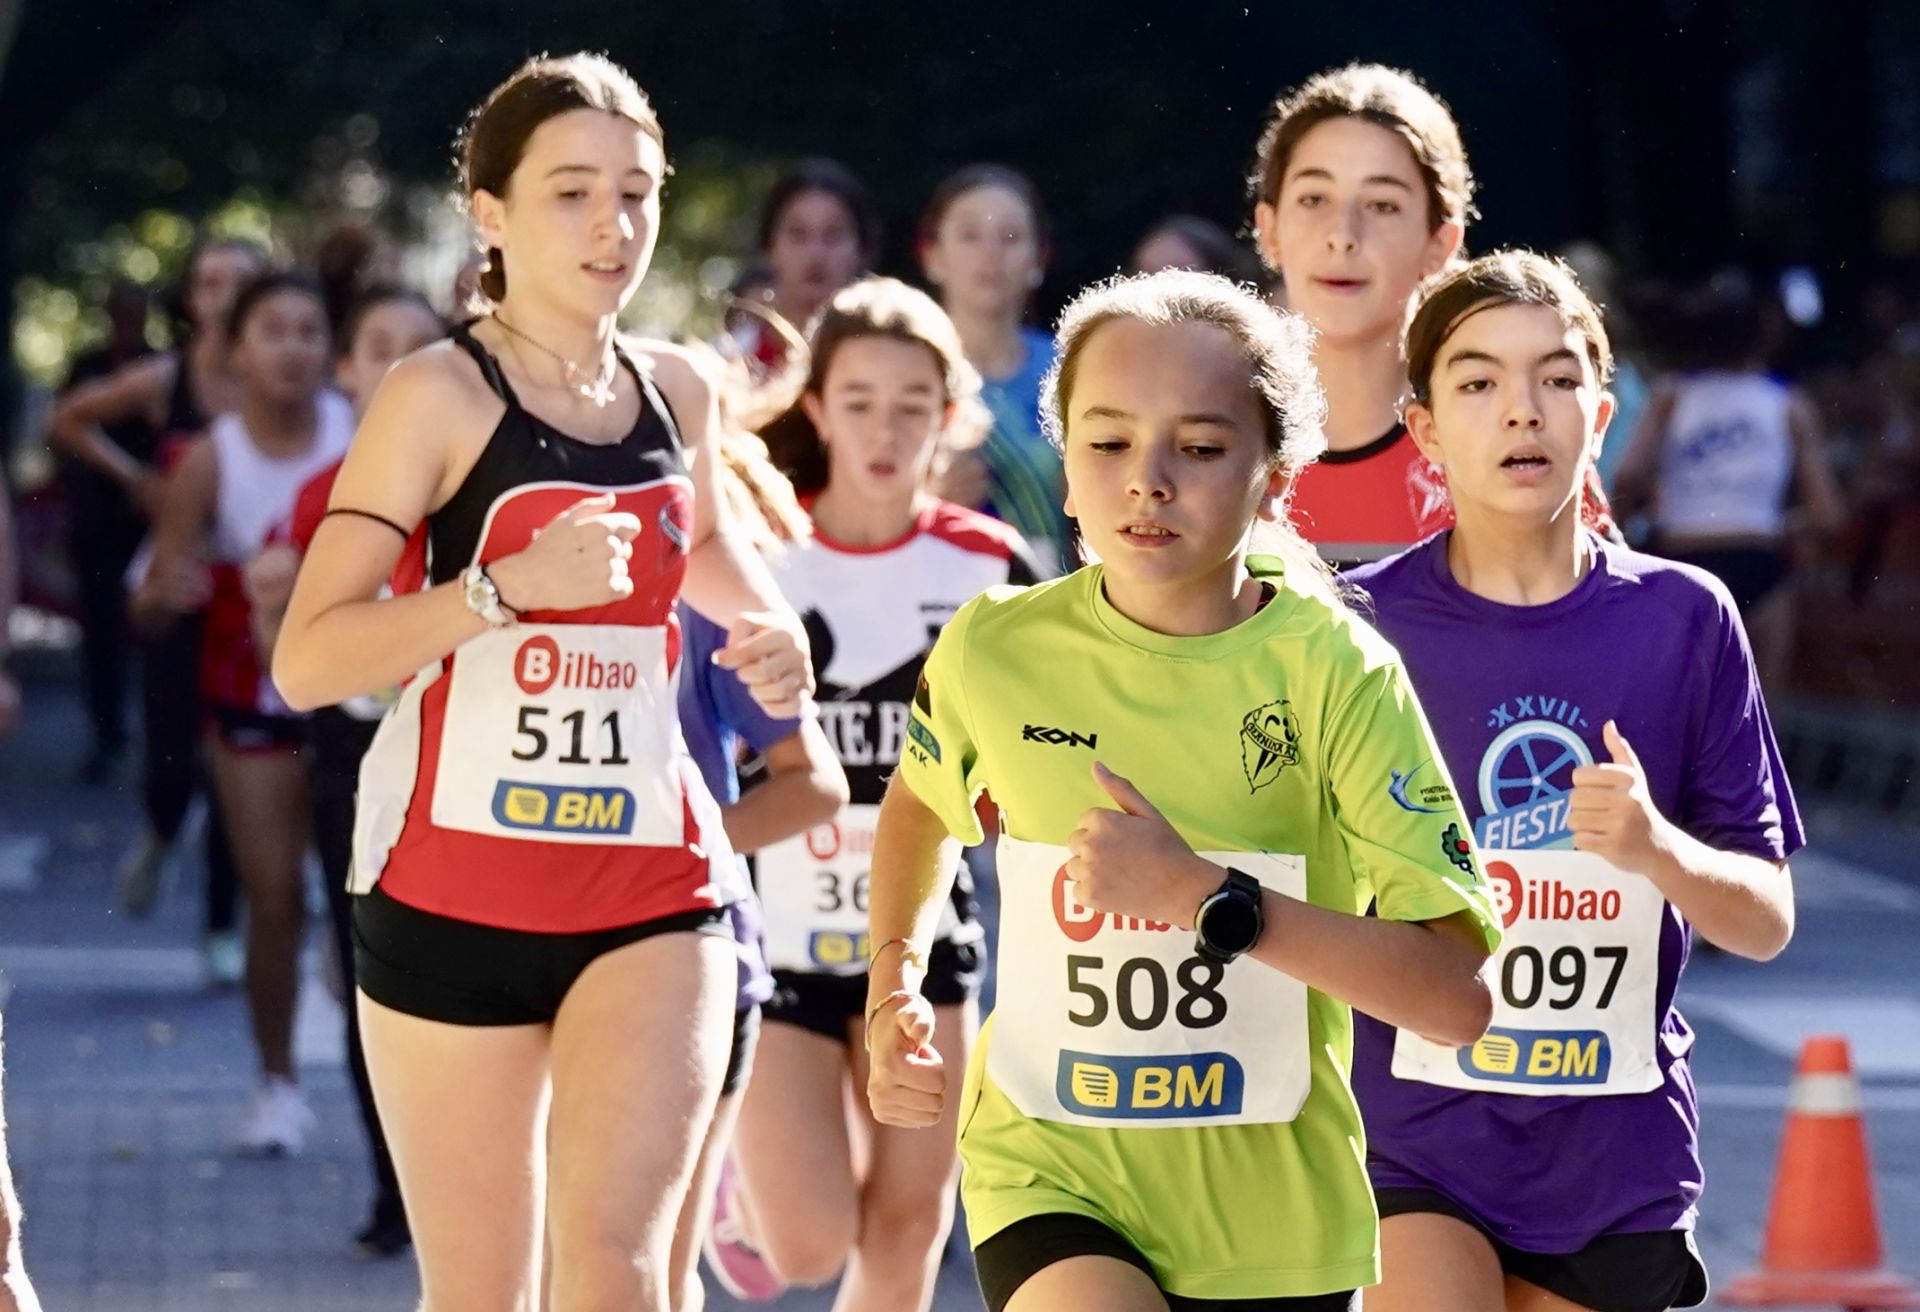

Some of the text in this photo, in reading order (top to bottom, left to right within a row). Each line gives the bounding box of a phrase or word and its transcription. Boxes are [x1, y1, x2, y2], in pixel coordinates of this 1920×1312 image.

[521, 646, 638, 690] Bilbao
[511, 705, 630, 765] 511
[553, 791, 626, 830] BM
[815, 869, 869, 914] 36
[1491, 876, 1622, 922] Bilbao
[1067, 953, 1228, 1031] 508
[1501, 944, 1628, 1010] 097
[1526, 1038, 1600, 1078] BM
[1131, 1062, 1225, 1109] BM
